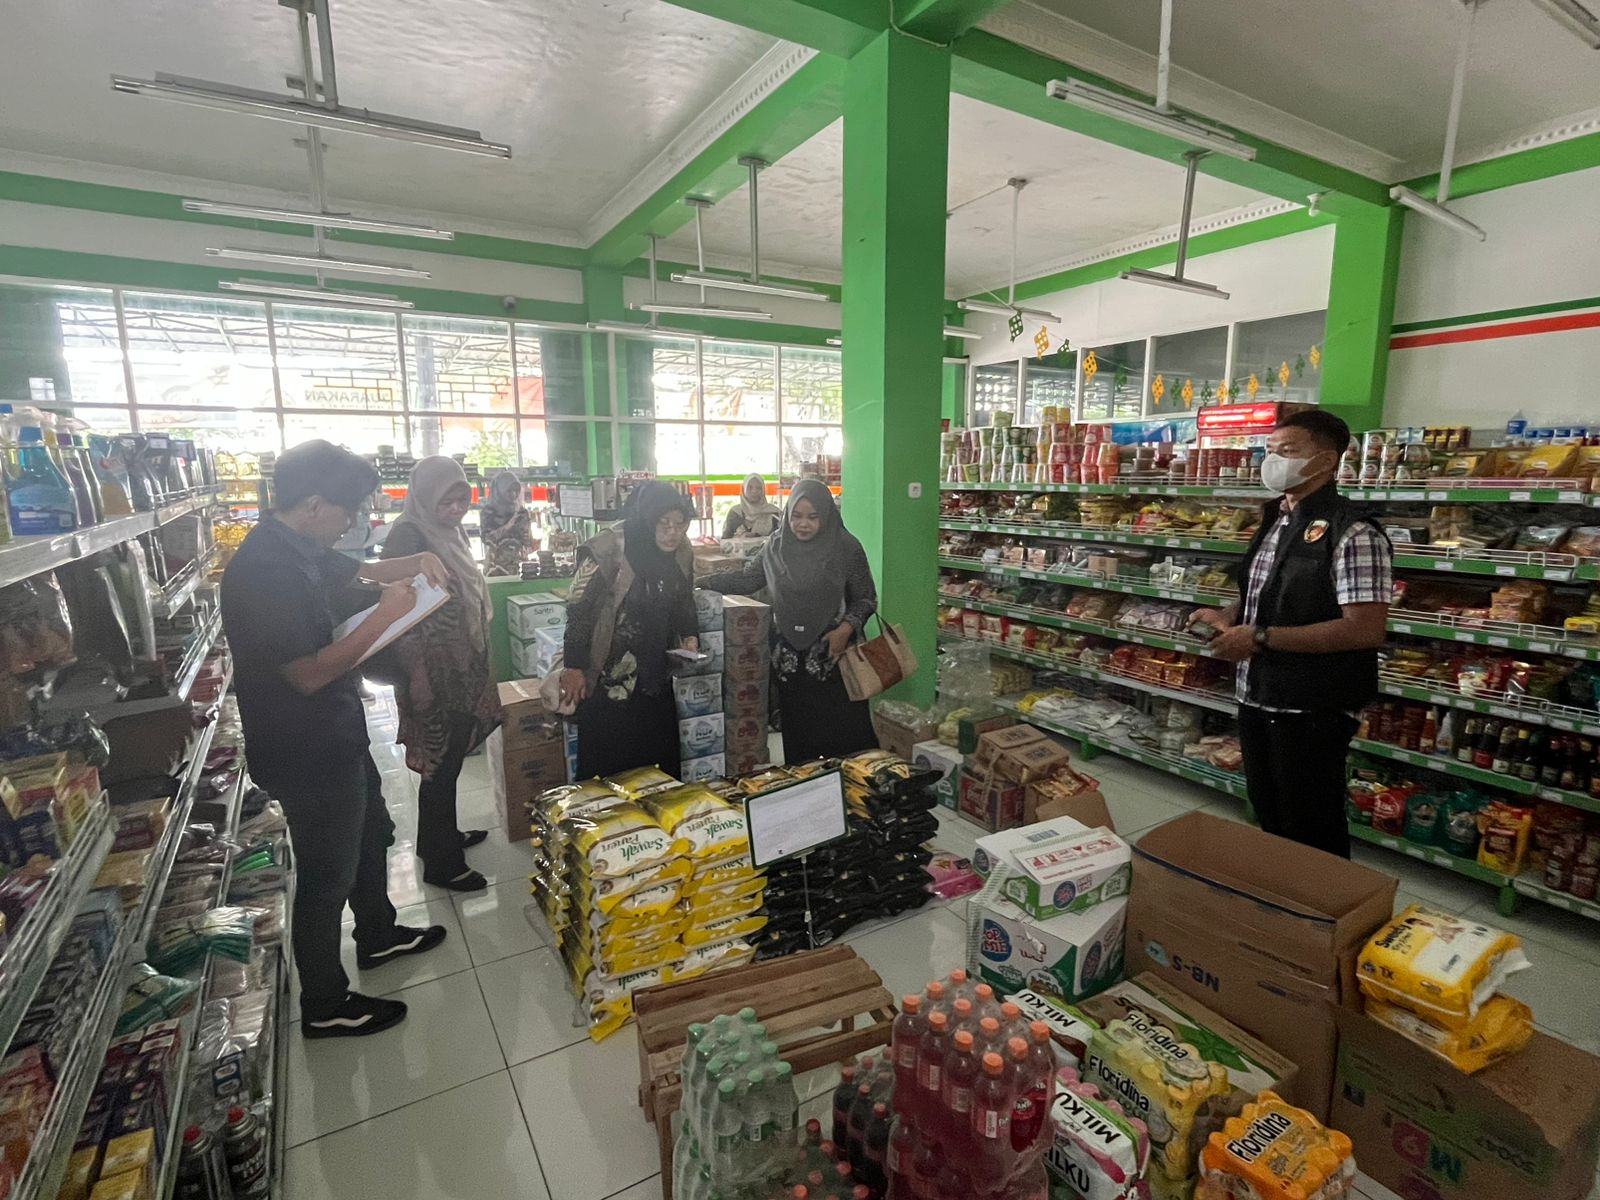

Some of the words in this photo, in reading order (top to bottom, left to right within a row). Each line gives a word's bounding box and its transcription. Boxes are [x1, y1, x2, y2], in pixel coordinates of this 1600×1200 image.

[534, 607, 554, 615] Santri
[601, 834, 639, 854] Panen
[703, 818, 744, 838] Sawah
[620, 837, 664, 861] Sawah
[1171, 955, 1220, 993] NB-S
[1017, 992, 1076, 1028] MILKU
[1122, 1012, 1189, 1059] Floridina
[1089, 1055, 1150, 1112] Floridina
[1055, 1091, 1121, 1144] MILKU
[1227, 1110, 1292, 1164] Floridina
[1043, 1146, 1091, 1193] ILKU
